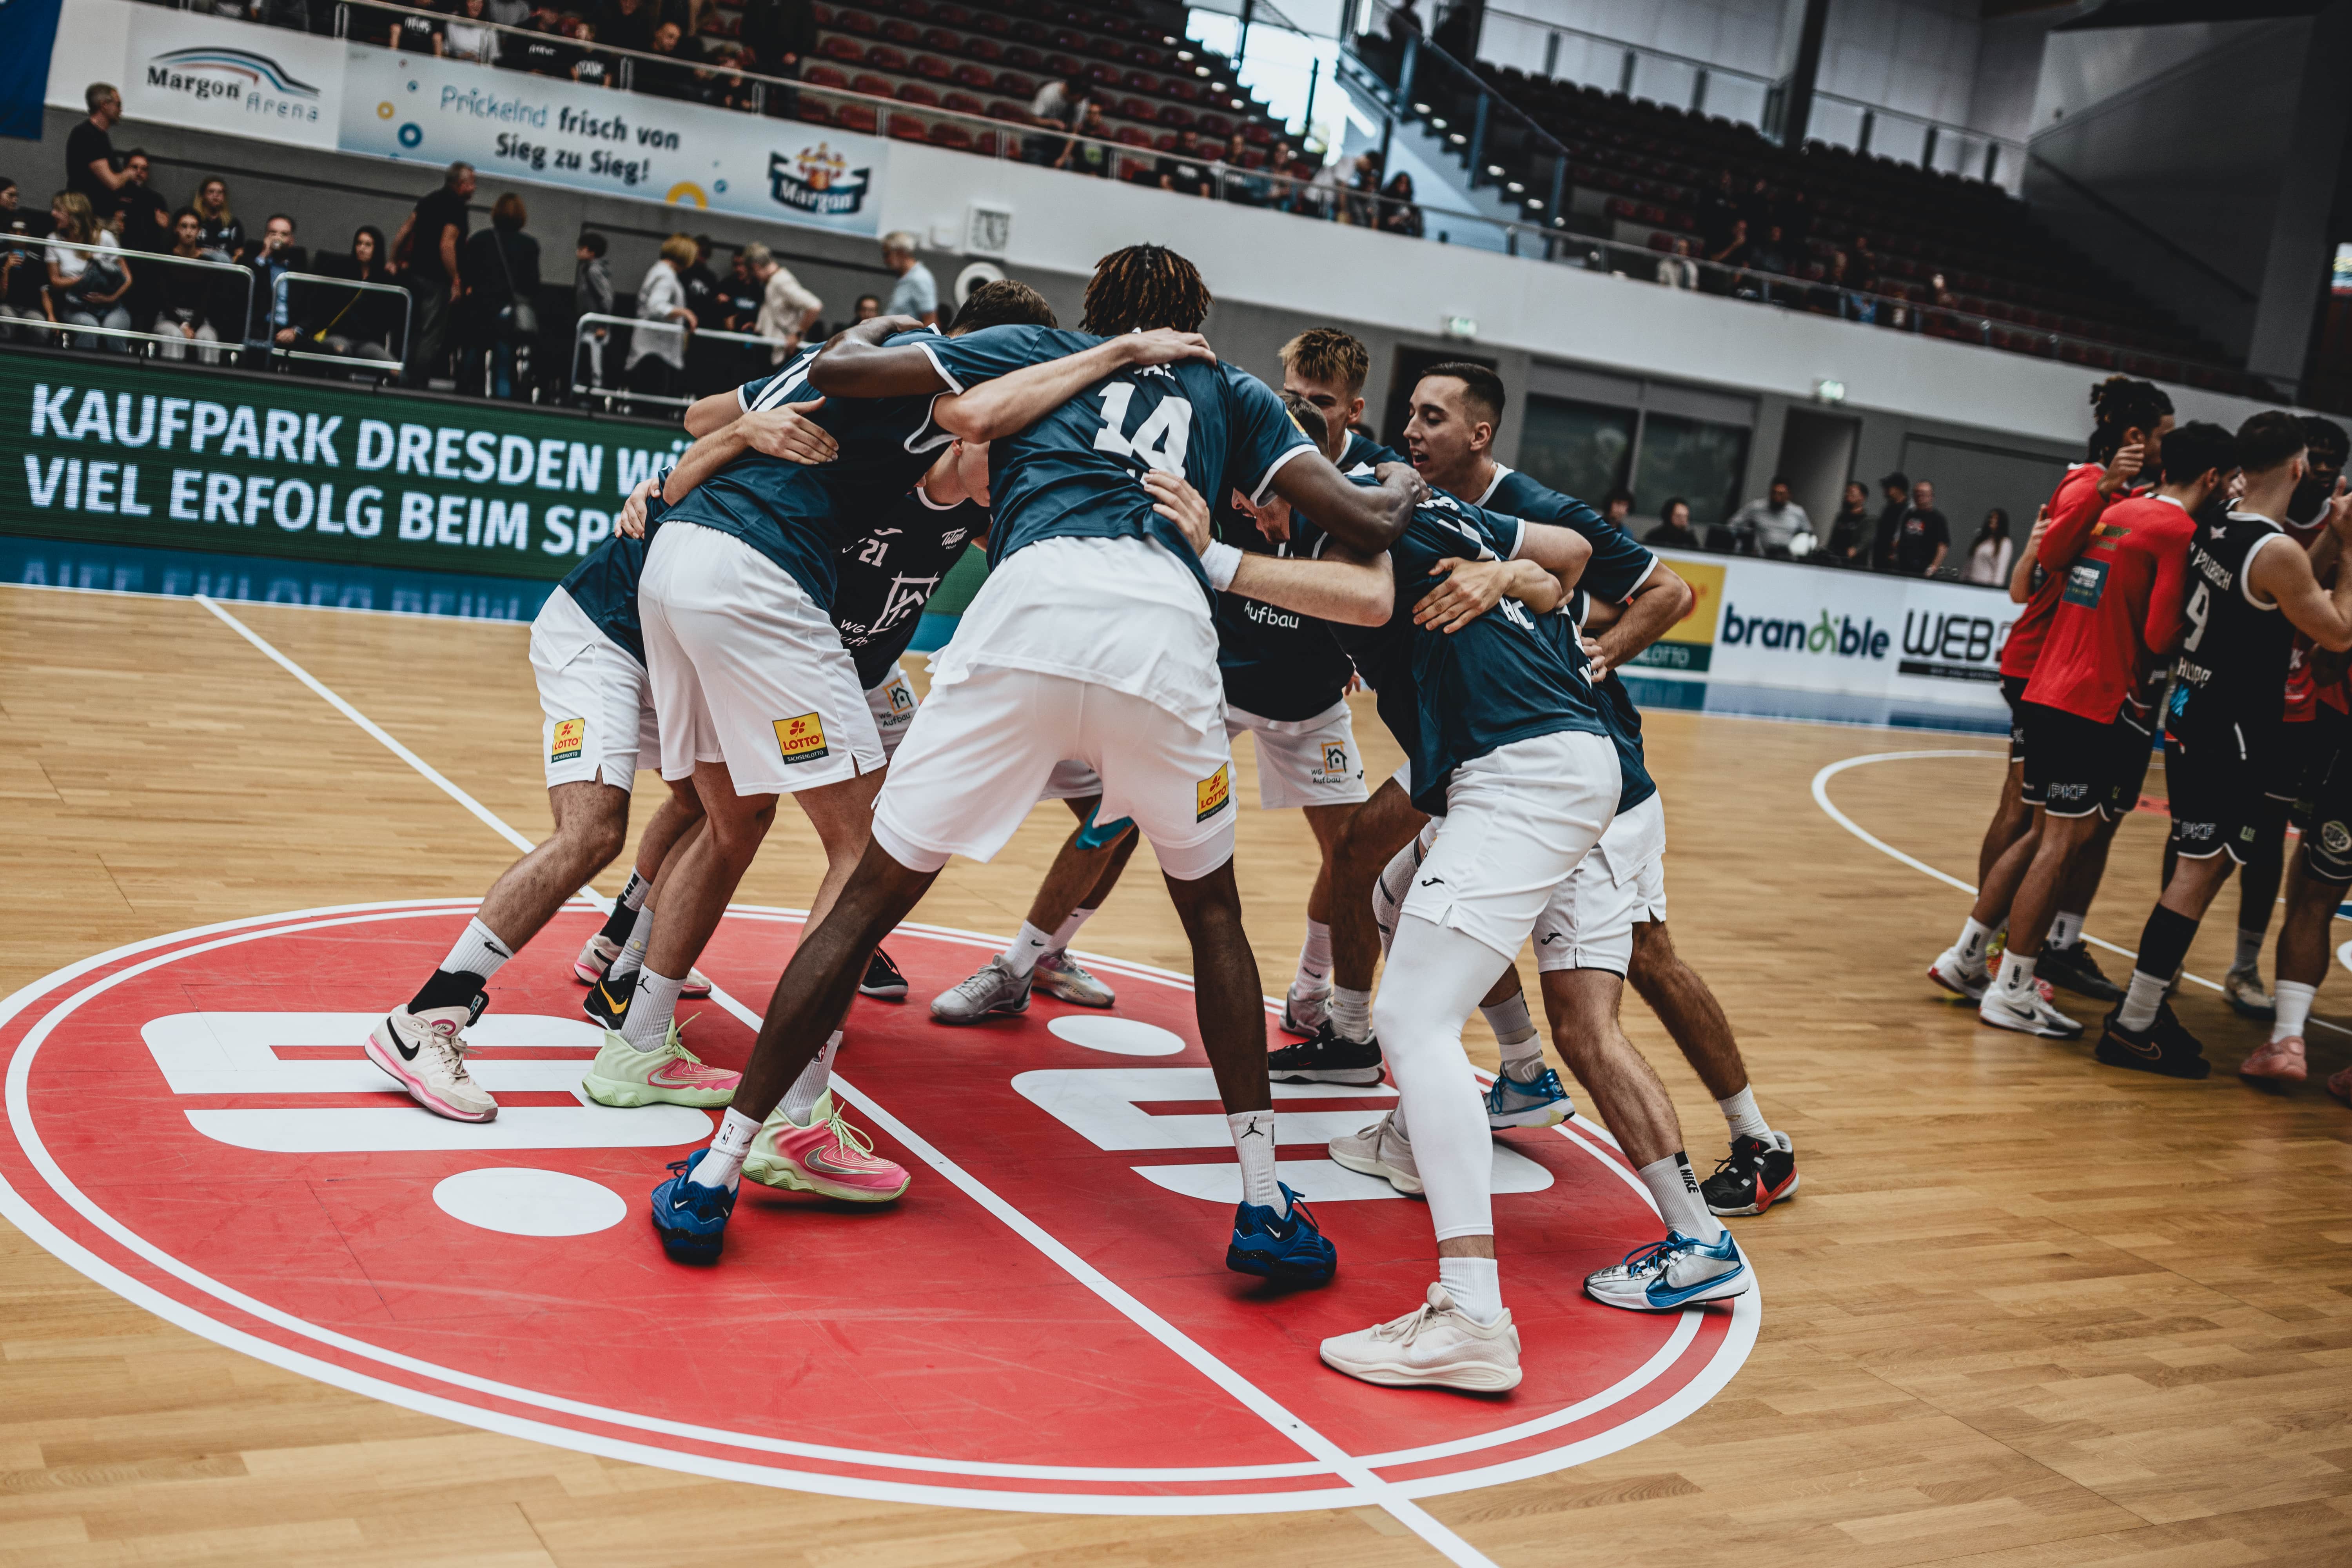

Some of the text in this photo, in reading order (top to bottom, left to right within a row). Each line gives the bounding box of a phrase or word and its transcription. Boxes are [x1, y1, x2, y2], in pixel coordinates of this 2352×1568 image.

[147, 66, 240, 100] Margon
[246, 92, 320, 122] Arena
[440, 85, 680, 151] Prickelnd frisch von
[495, 133, 650, 186] Sieg zu Sieg!
[780, 180, 853, 213] Margon
[30, 383, 343, 467] KAUFPARK
[356, 419, 604, 494] DRESDEN
[1093, 381, 1192, 485] 14
[24, 454, 621, 556] VIEL ERFOLG BEIM SP
[858, 539, 889, 567] 21
[840, 619, 865, 633] WG
[1244, 600, 1299, 629] Aufbau
[2184, 580, 2210, 652] 9
[1721, 602, 1890, 659] brandible
[883, 713, 910, 728] Aufbau
[554, 751, 578, 760] SACHSENLOTTO
[555, 738, 579, 750] LOTTO
[783, 735, 820, 750] LOTTO
[788, 750, 824, 762] SACHSENLOTTO
[1201, 785, 1226, 809] LOTTO
[1680, 1169, 1699, 1193] NIKE
